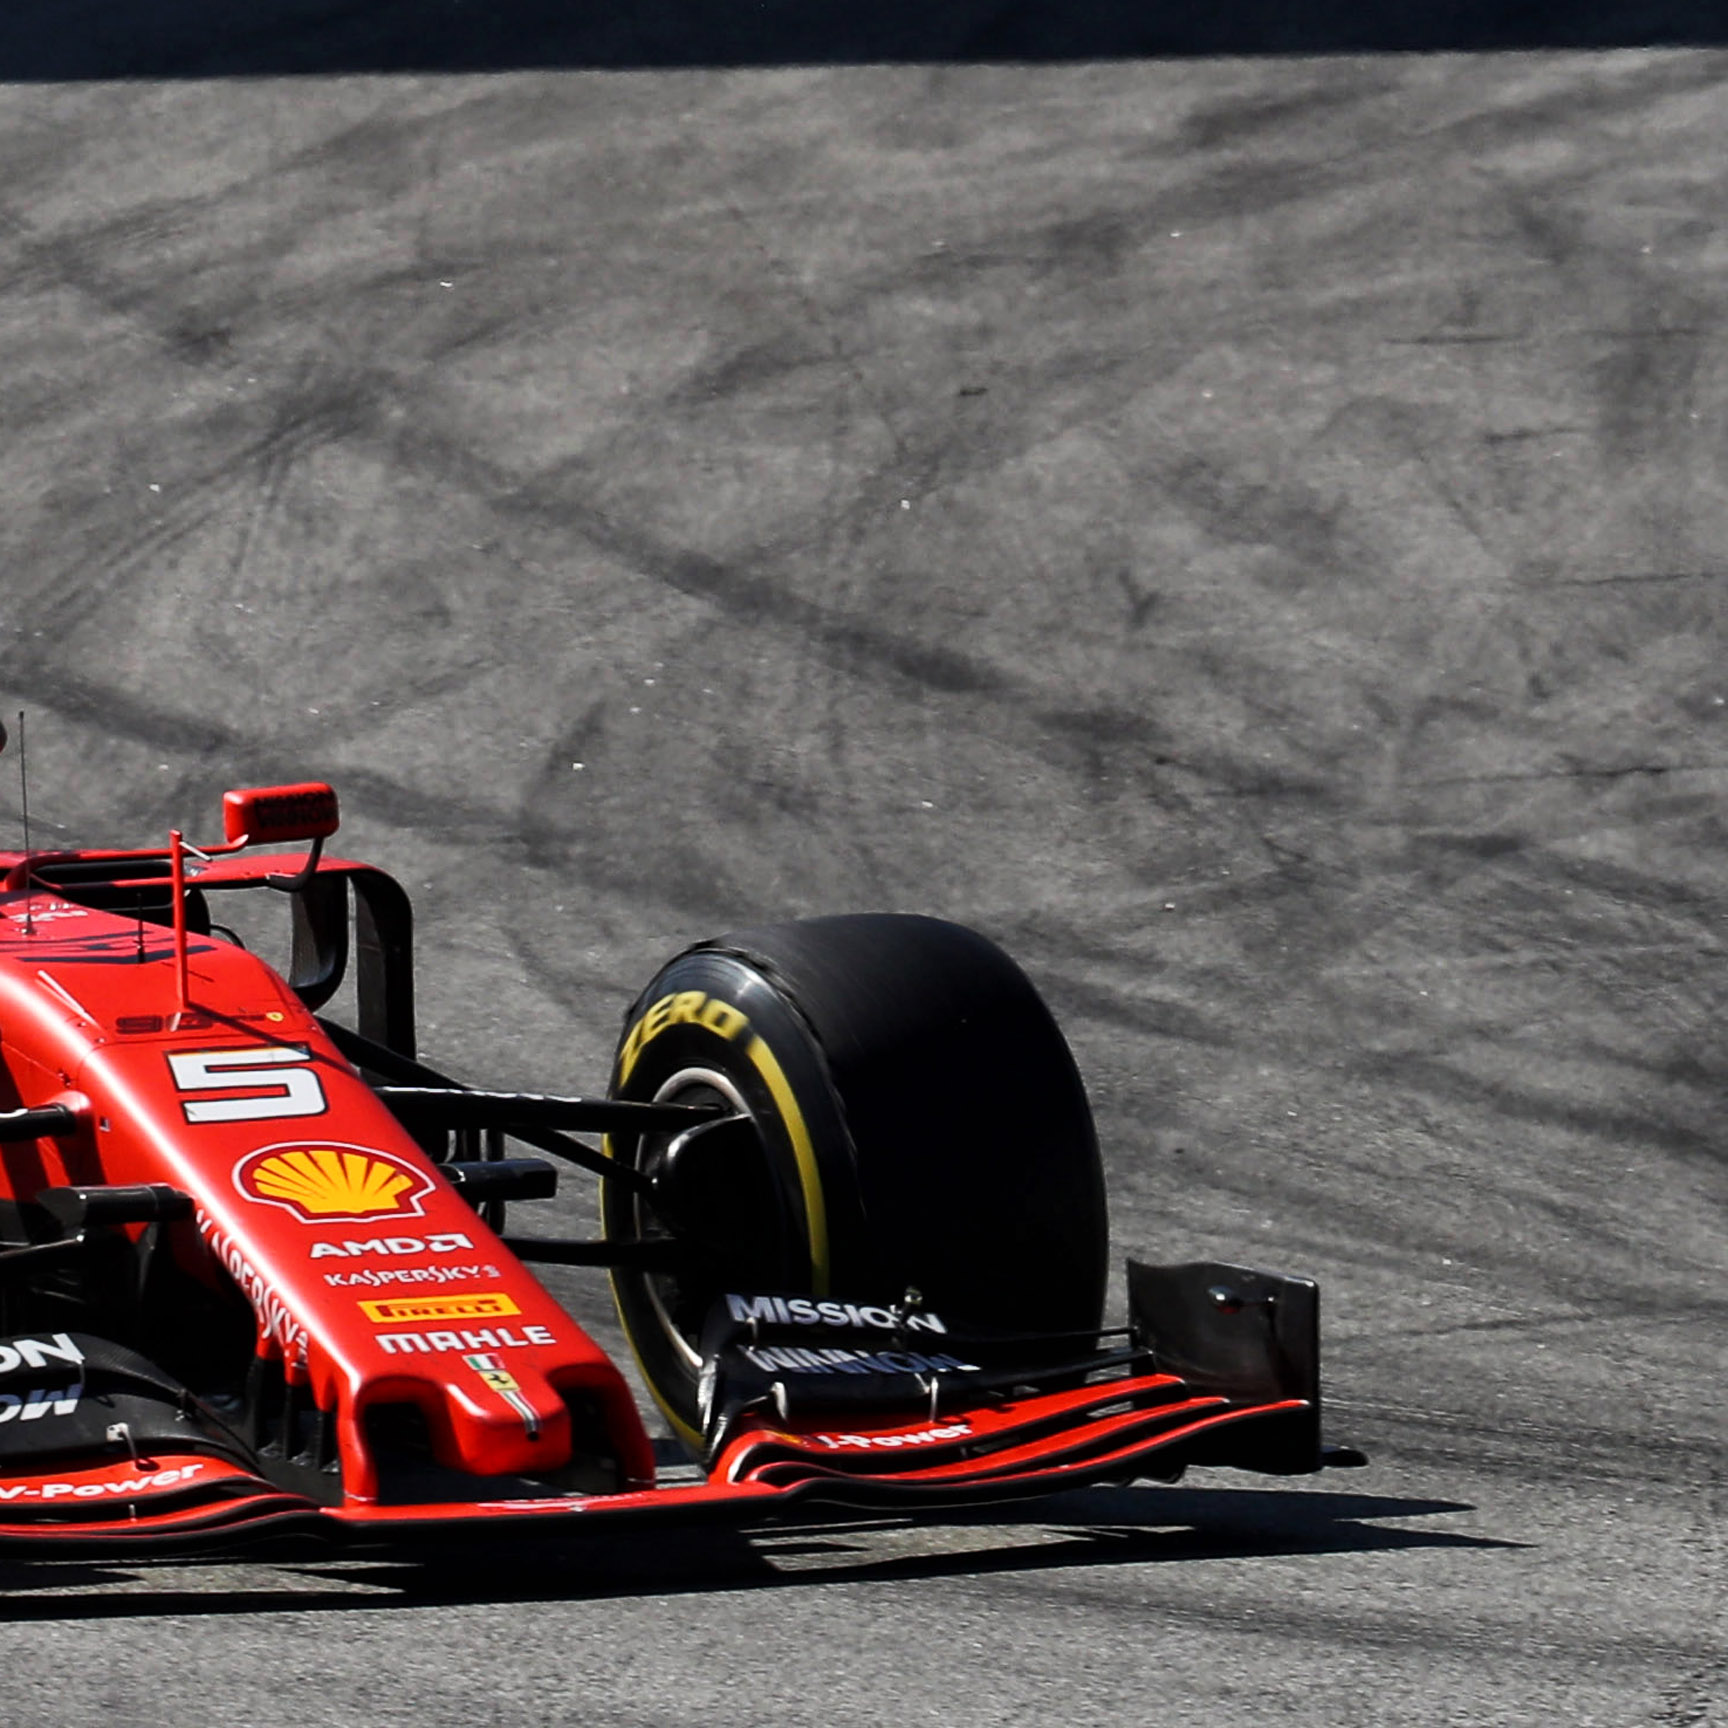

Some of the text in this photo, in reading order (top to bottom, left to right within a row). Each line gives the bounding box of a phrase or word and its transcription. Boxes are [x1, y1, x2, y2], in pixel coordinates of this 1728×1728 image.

[164, 1043, 329, 1125] 5
[310, 1236, 428, 1259] AMD
[324, 1266, 481, 1288] KASPERSKY
[725, 1293, 947, 1334] MISSION
[376, 1325, 557, 1355] MAHLE
